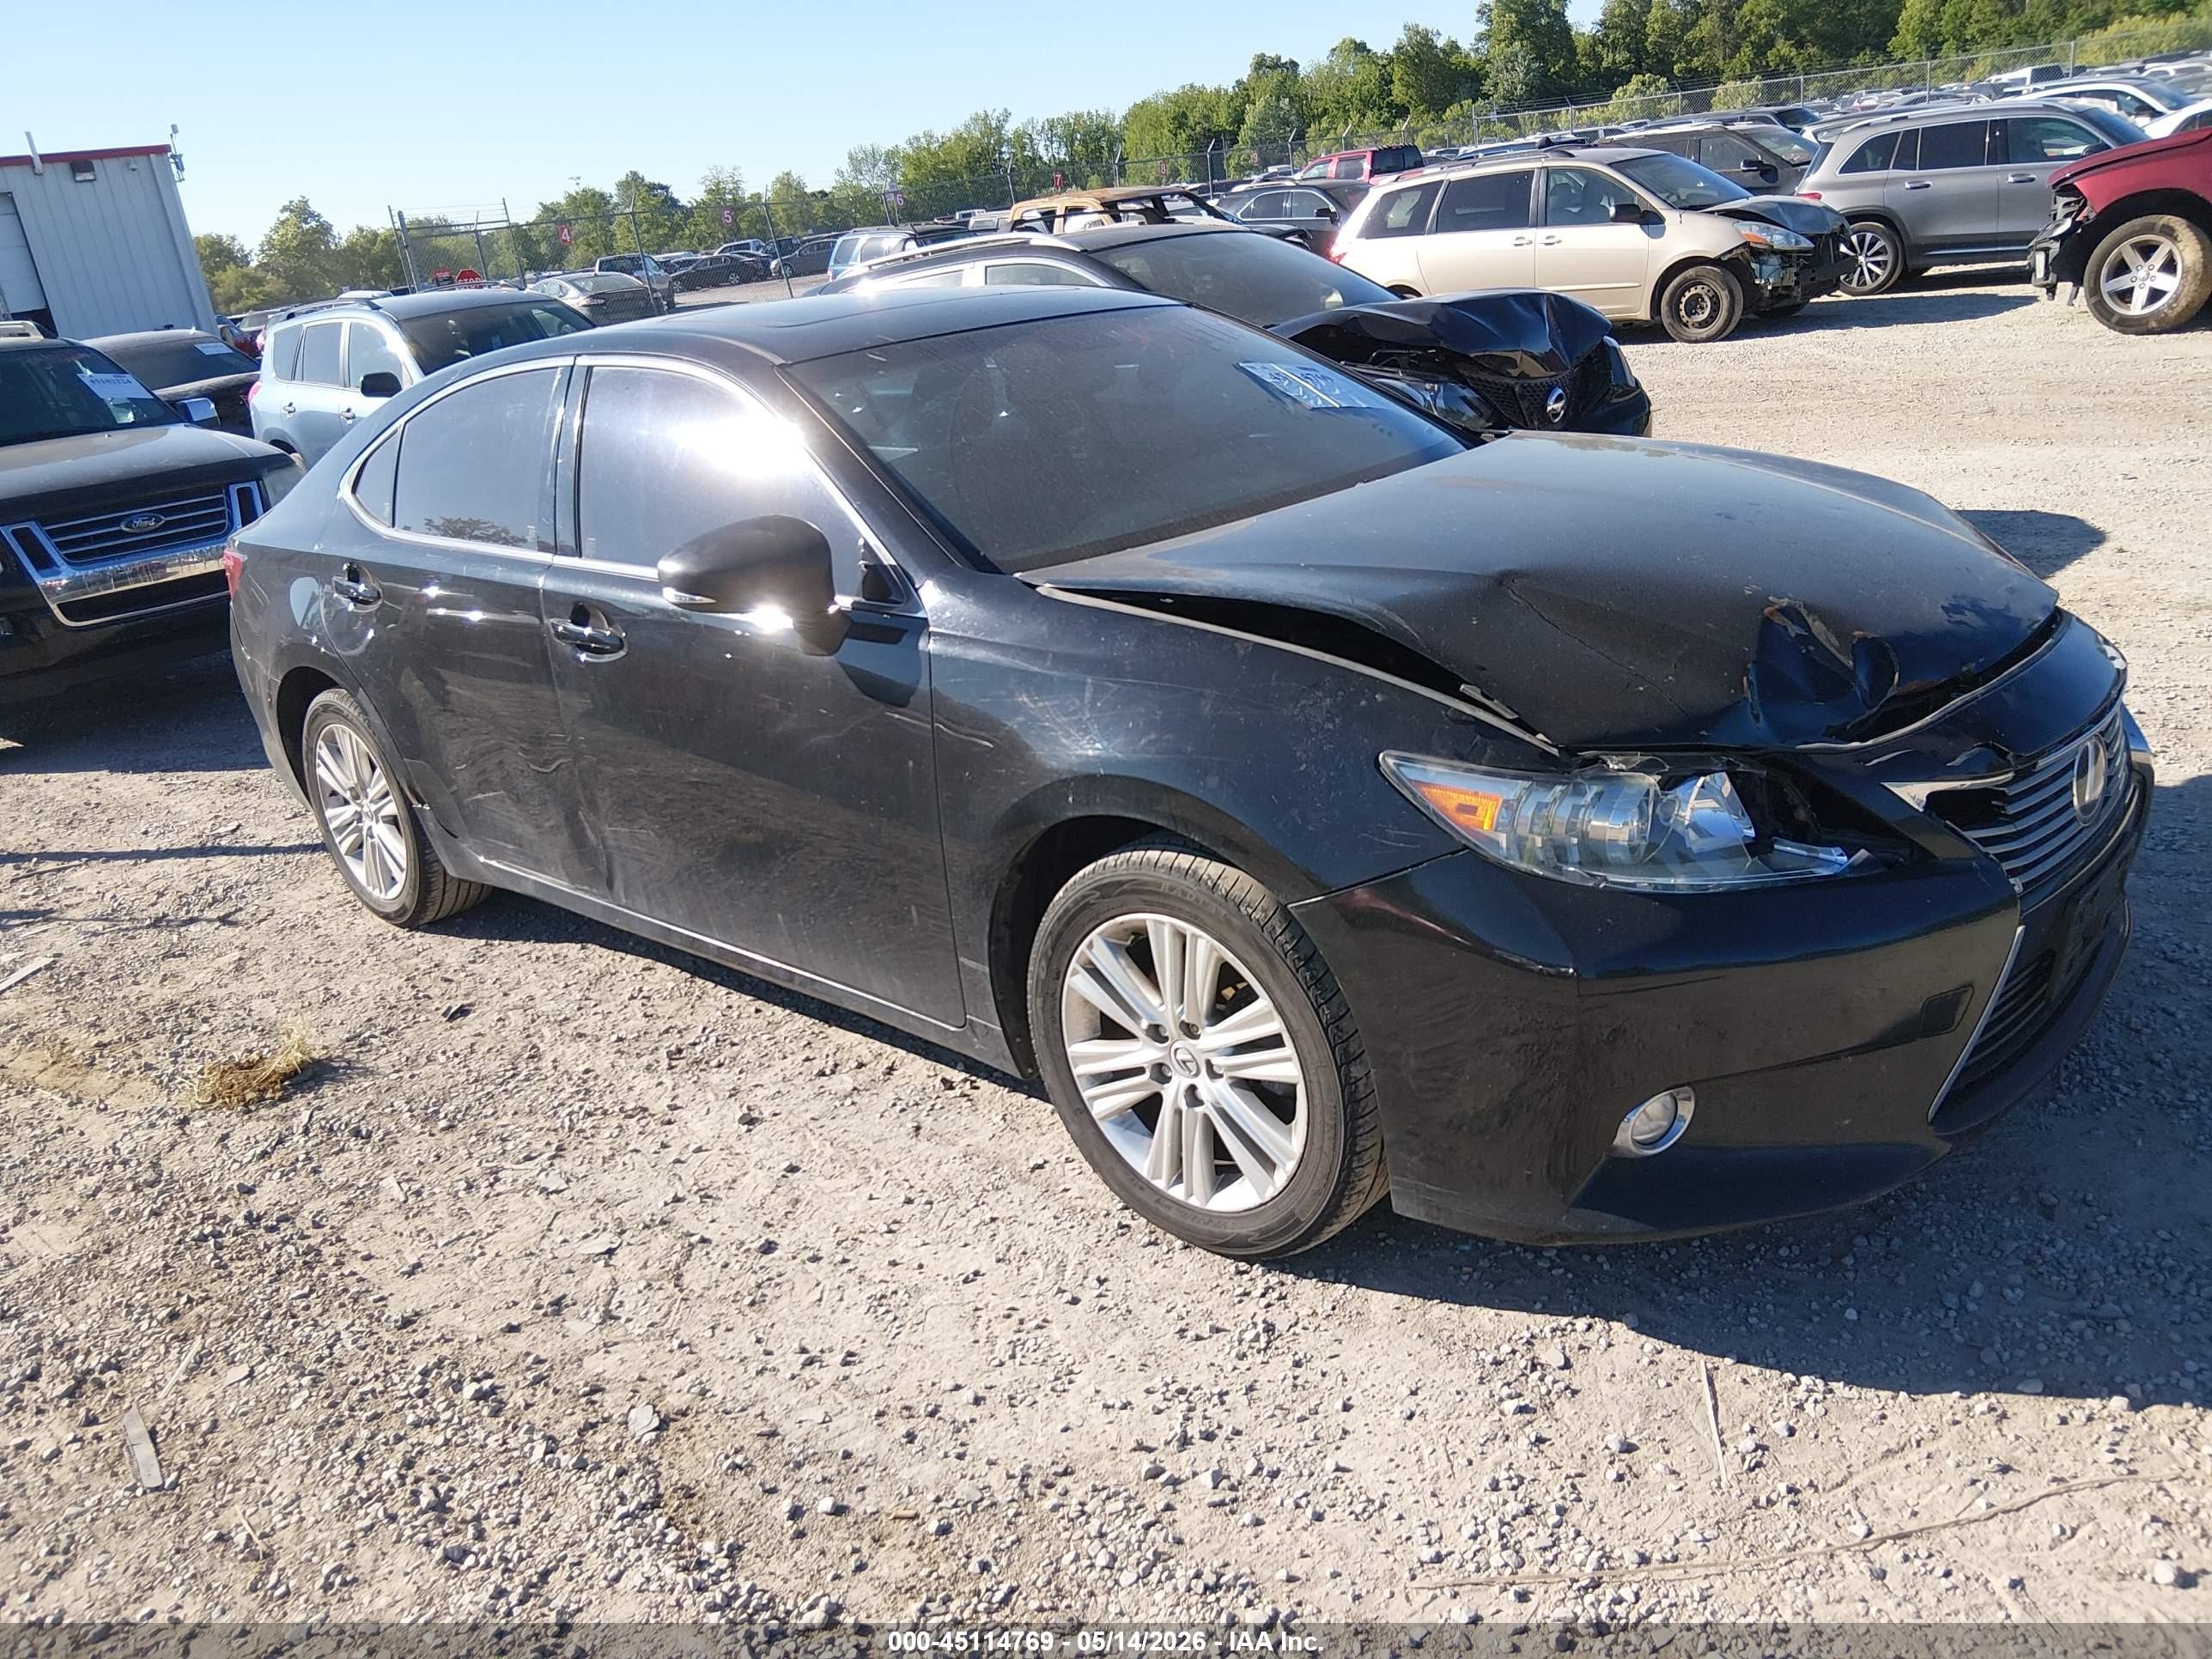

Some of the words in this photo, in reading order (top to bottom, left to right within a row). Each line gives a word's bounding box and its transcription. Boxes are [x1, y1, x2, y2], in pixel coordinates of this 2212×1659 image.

[1160, 163, 1166, 174] 8
[1054, 173, 1061, 186] 7
[896, 193, 904, 206] 6
[724, 210, 732, 223] 5
[562, 228, 571, 242] 4
